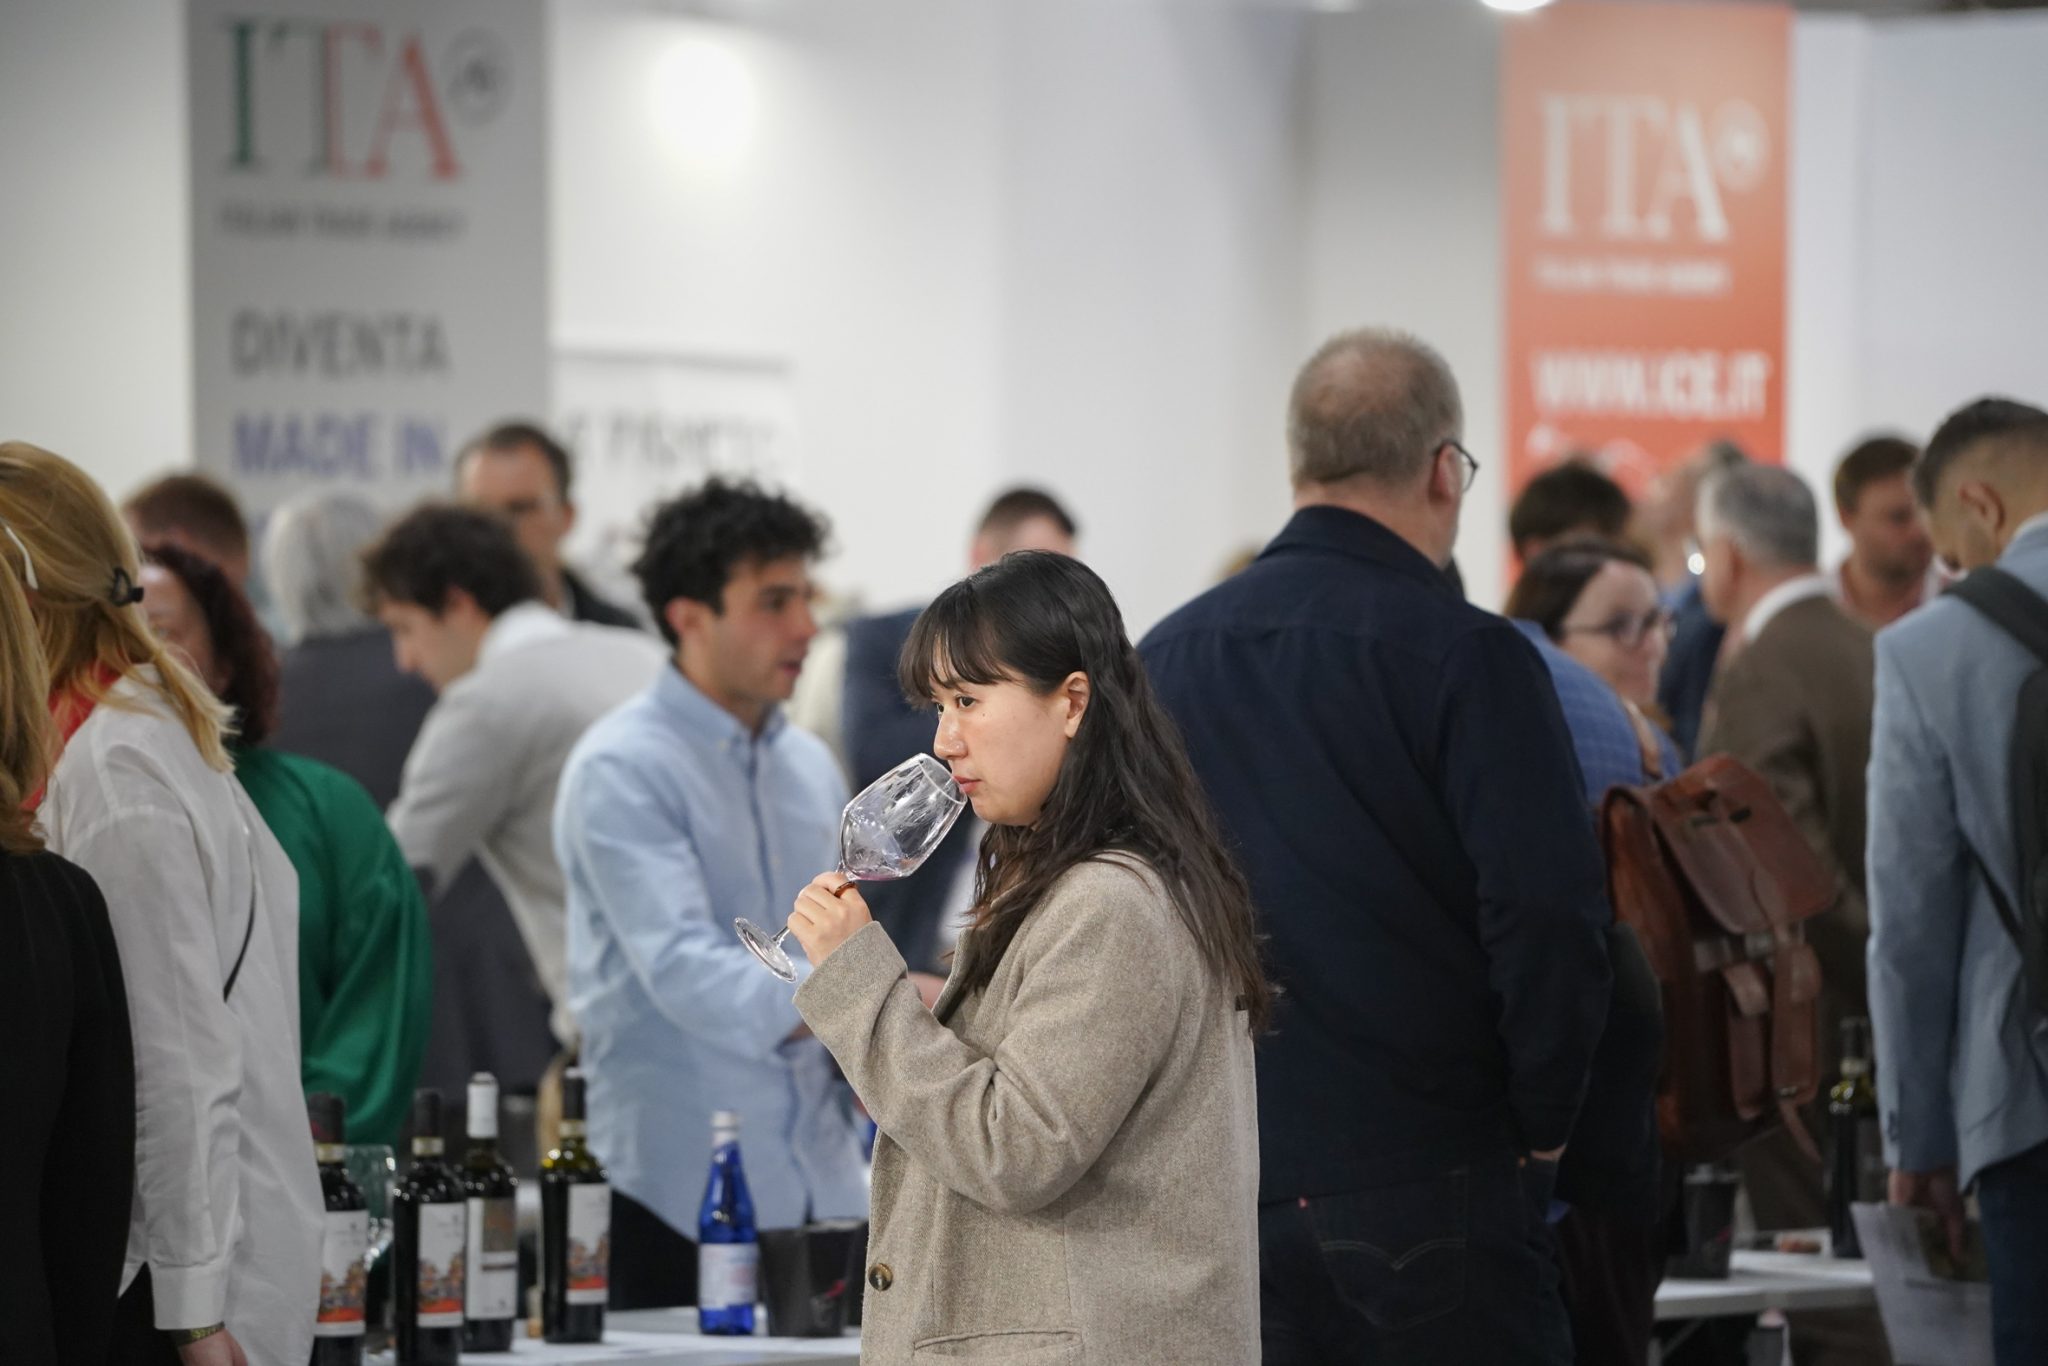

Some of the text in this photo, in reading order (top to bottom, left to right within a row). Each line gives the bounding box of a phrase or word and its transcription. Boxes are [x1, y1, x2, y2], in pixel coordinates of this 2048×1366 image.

[222, 19, 462, 178] ITA
[1540, 98, 1730, 241] ITA
[232, 312, 449, 375] DIVENTA
[233, 413, 446, 477] MADE IN
